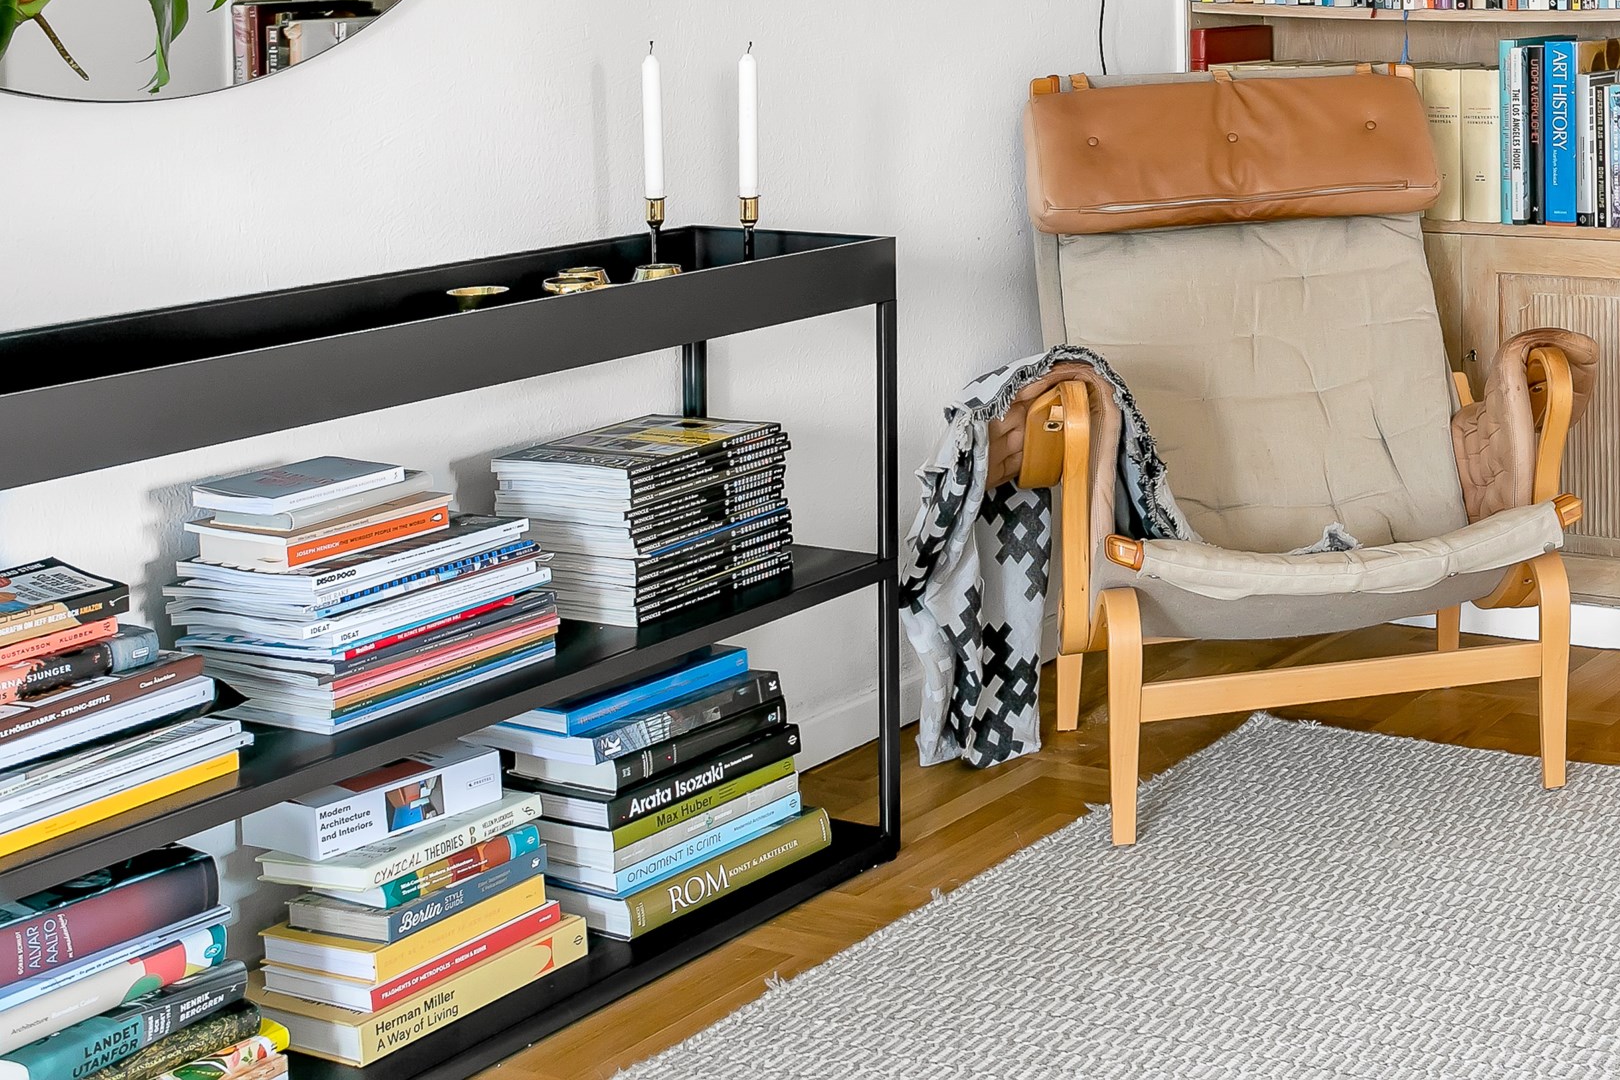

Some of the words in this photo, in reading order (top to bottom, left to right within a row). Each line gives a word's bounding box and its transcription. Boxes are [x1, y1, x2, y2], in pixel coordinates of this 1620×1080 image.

[1552, 50, 1567, 81] ART
[1512, 89, 1520, 102] THE
[1553, 84, 1568, 150] HISTORY
[296, 546, 315, 557] JOSEPH
[316, 541, 339, 552] HENRICH
[310, 623, 330, 635] IDEAT
[340, 629, 360, 641] IDEAT
[1, 642, 50, 659] GUSTAVSSON
[59, 630, 94, 644] KLUBBEN
[27, 664, 72, 683] SJUNGER
[628, 790, 672, 818] Arata
[675, 762, 724, 798] Isozaki
[319, 805, 351, 820] Modern
[320, 809, 371, 832] Architecture
[656, 807, 679, 828] Max
[681, 794, 713, 817] Huber
[321, 830, 337, 842] and
[339, 820, 374, 838] Interiors
[374, 853, 422, 885] CYNICAL
[424, 834, 464, 862] THEORIES
[667, 864, 730, 914] ROM
[729, 860, 751, 878] KONST
[752, 857, 758, 867] &
[758, 839, 798, 861] ARKITEKTUR
[444, 888, 464, 904] STYLE
[444, 896, 464, 911] GUIDE
[399, 902, 443, 934] Berlin
[29, 925, 40, 968] ALVAR
[46, 919, 58, 964] AALTO
[180, 992, 210, 1012] HENRIK
[180, 994, 224, 1022] BERGGREN
[375, 1007, 421, 1035] Herman
[424, 989, 455, 1013] Miller
[84, 1022, 140, 1058] LANDET
[377, 1039, 386, 1052] A
[386, 1028, 412, 1049] Way
[414, 1019, 425, 1033] of
[427, 1004, 459, 1030] Living
[72, 1038, 138, 1078] UTANFÖR
